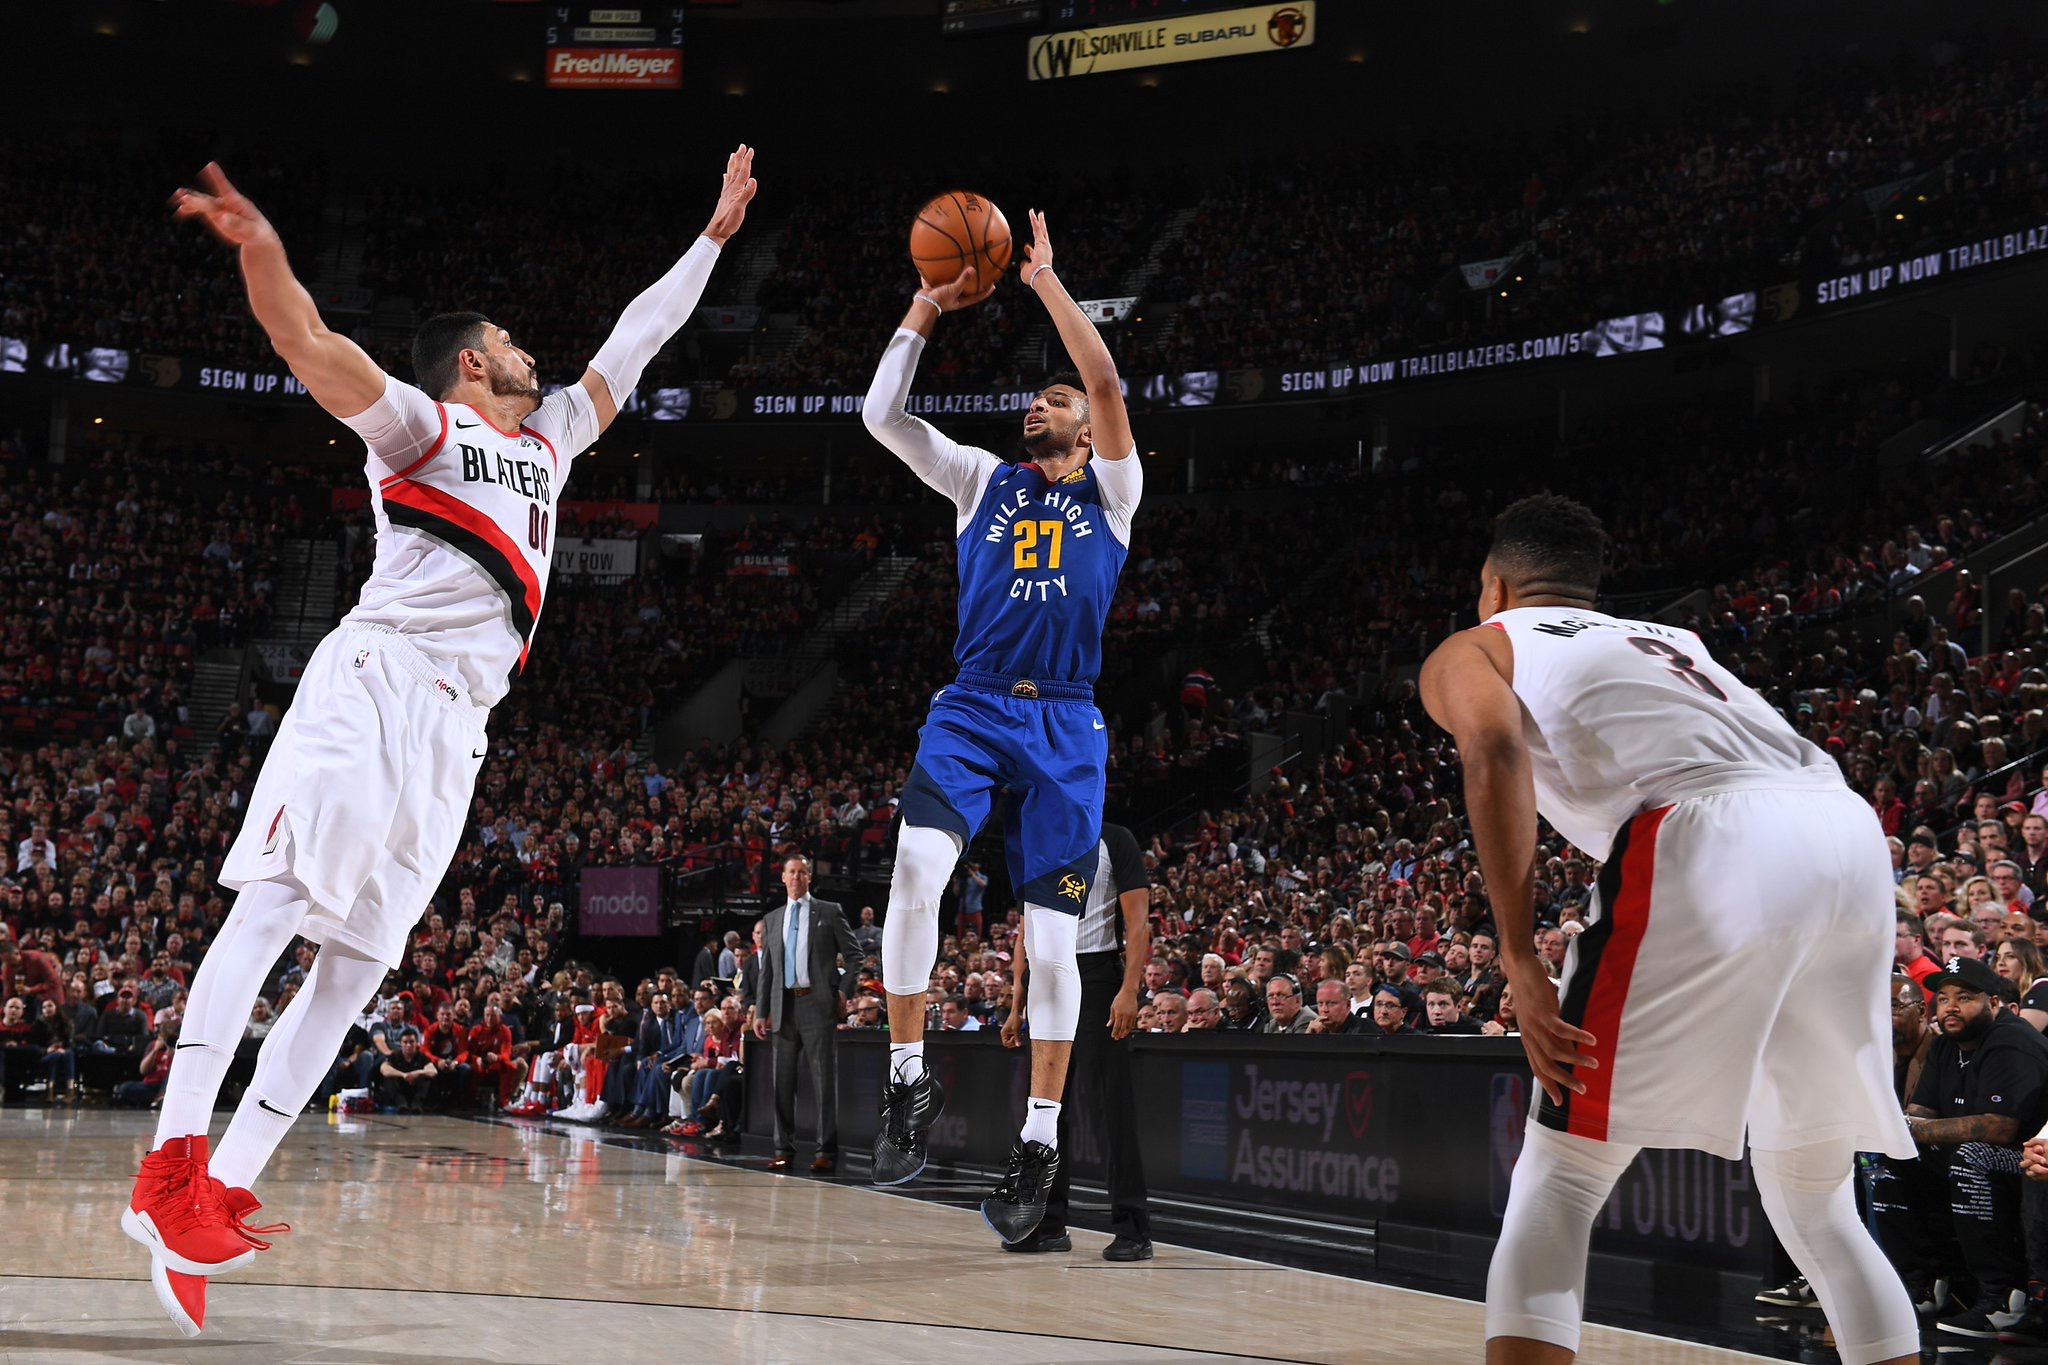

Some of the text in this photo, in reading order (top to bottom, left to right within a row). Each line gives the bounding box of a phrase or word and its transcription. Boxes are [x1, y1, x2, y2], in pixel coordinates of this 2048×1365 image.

[1174, 25, 1256, 46] SUBARU
[1817, 273, 1862, 304] SIGN
[1868, 265, 1893, 291] UP
[1898, 253, 1942, 284] NOW
[200, 367, 309, 395] SIGN UP NO
[1281, 331, 1586, 392] SIGN UP NOW TRAILBLAZERS.COM/5
[753, 396, 796, 414] SIGN
[803, 396, 824, 413] UP
[906, 391, 1035, 413] ILBLAZERS.COM
[457, 443, 550, 506] BLAZERS
[528, 502, 548, 557] 00
[986, 488, 1093, 543] MILE HIGH
[1013, 519, 1064, 570] 27
[1010, 575, 1068, 602] CITY
[435, 678, 459, 701] ripcity
[1626, 636, 1728, 703] 3
[587, 890, 649, 915] moda
[1235, 1063, 1341, 1143] Jersey
[1232, 1128, 1400, 1203] Assurance
[1632, 1147, 1750, 1247] Store
